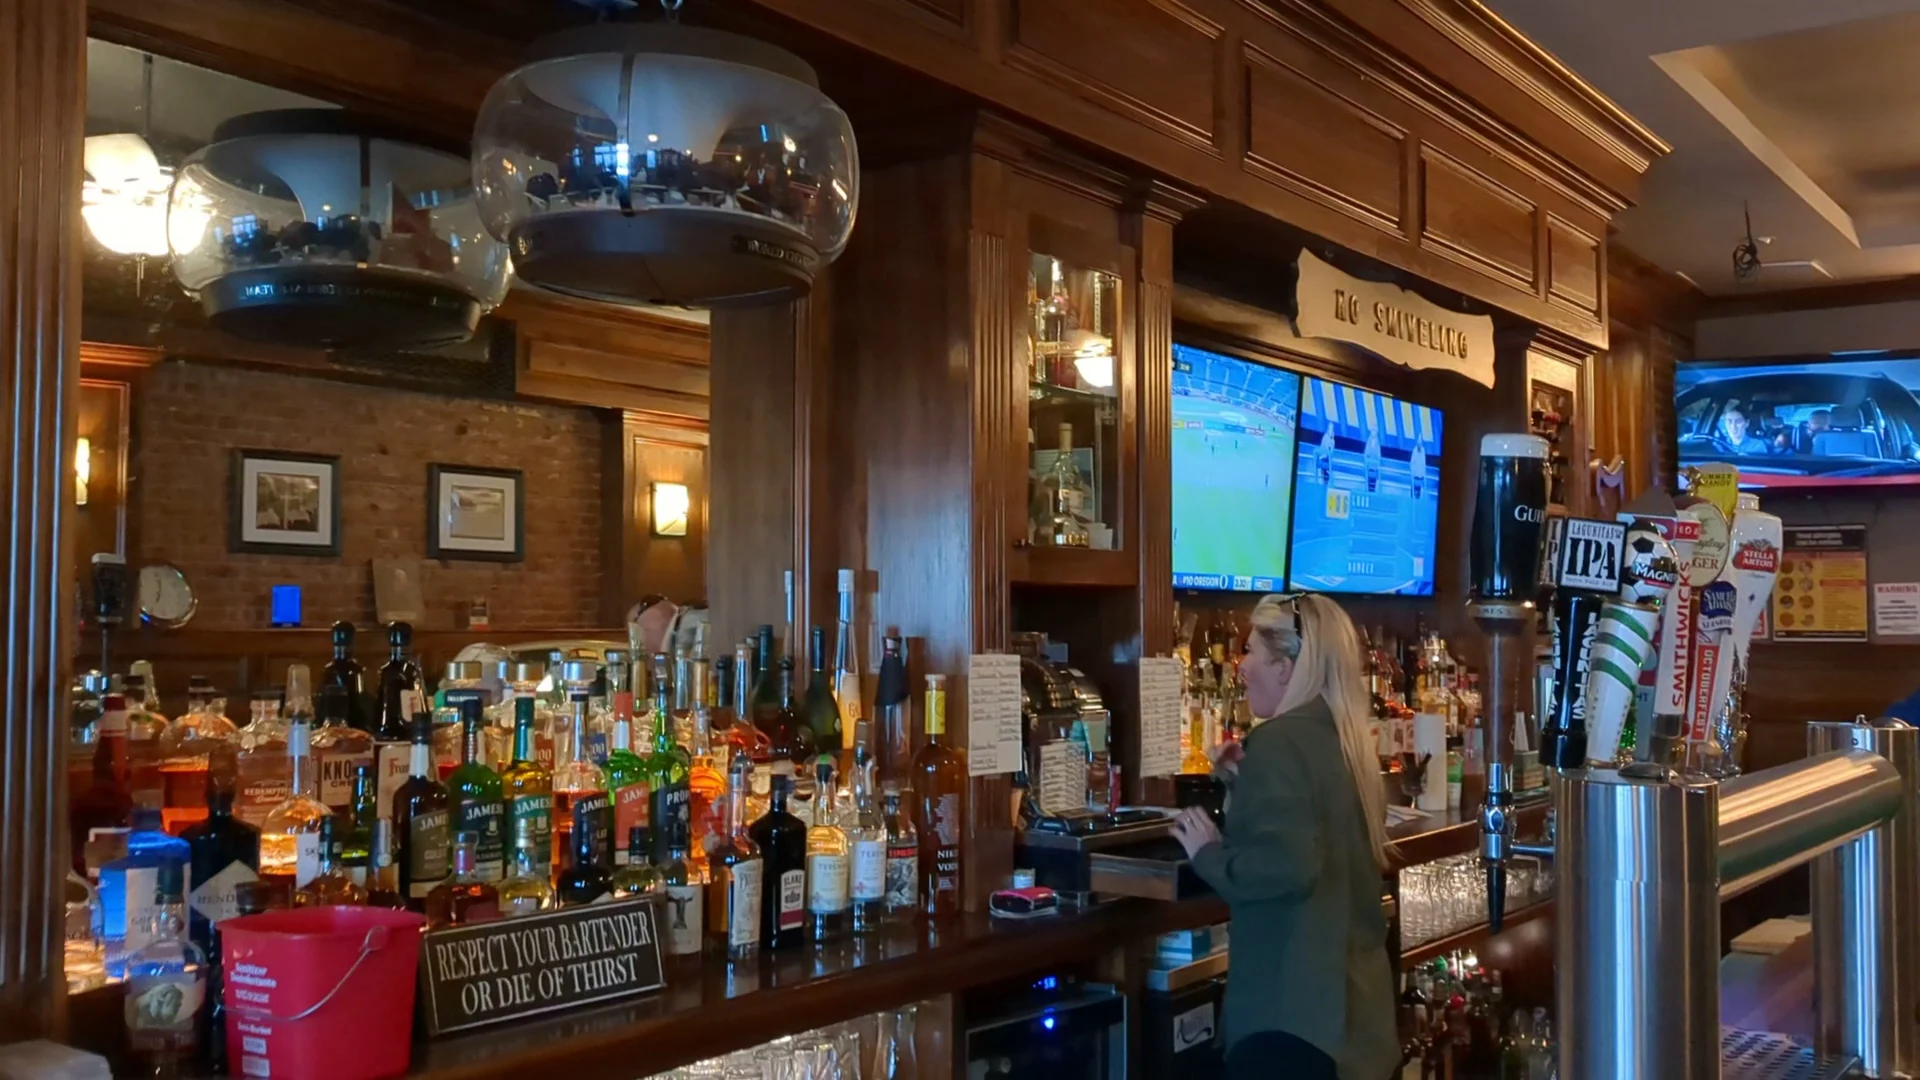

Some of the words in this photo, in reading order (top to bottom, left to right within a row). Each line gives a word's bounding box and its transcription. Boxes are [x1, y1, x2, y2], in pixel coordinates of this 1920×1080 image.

[1333, 288, 1361, 326] NO
[1373, 301, 1469, 360] SNIVELING
[1571, 522, 1616, 539] LAGUNITAS
[1564, 536, 1617, 580] IPA
[1691, 556, 1719, 571] GER
[1742, 557, 1774, 569] ARTOIS
[1743, 549, 1774, 561] STELLA
[1194, 576, 1219, 587] OREGON
[1671, 560, 1692, 707] SMITHWICKS
[435, 932, 510, 982] RESPECT
[510, 922, 562, 969] YOUR
[558, 911, 652, 961] BARTENDER
[461, 980, 501, 1016] OR
[499, 972, 536, 1009] DIE
[537, 966, 564, 1000] OF
[565, 952, 639, 993] THIRST
